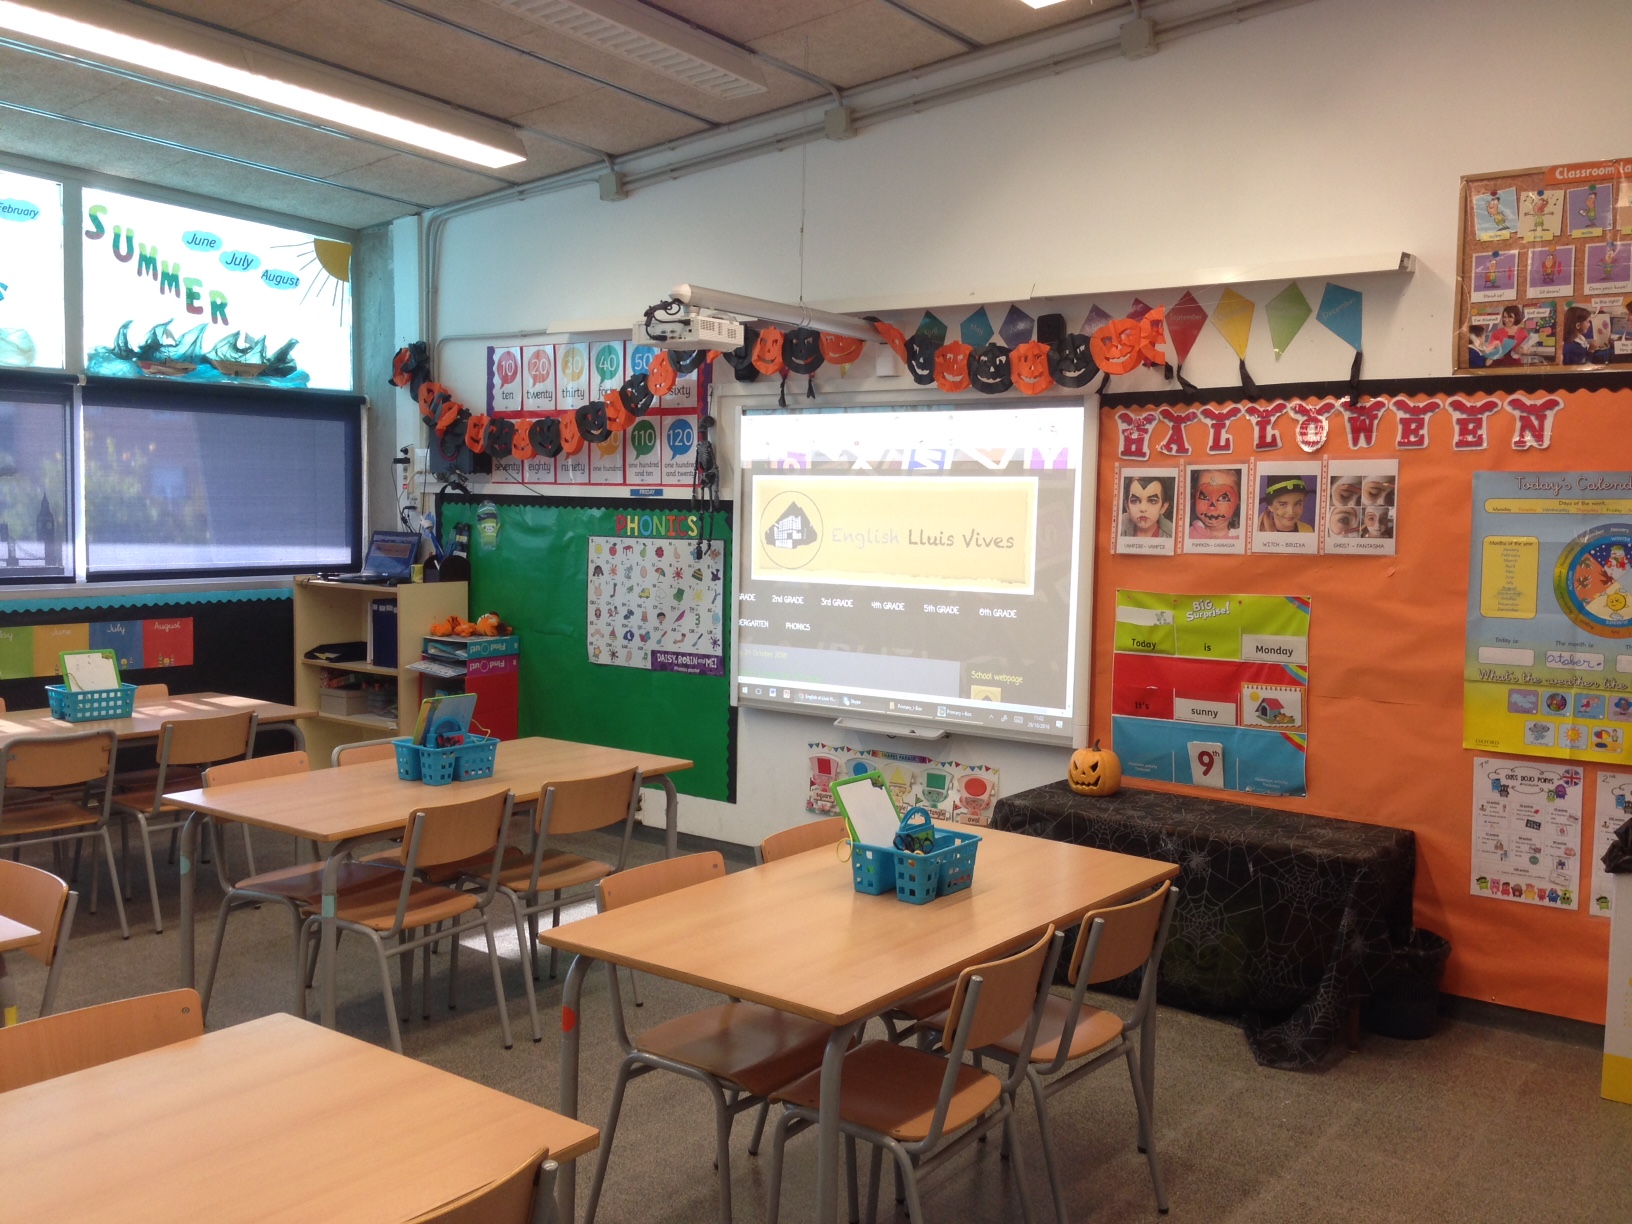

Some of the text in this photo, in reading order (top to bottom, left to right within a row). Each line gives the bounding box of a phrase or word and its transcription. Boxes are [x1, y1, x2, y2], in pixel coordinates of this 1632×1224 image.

[1555, 166, 1615, 180] Classroom
[186, 230, 217, 248] June
[84, 204, 230, 326] SUMMER
[225, 253, 254, 270] July
[261, 269, 300, 288] August
[1322, 298, 1356, 319] December
[1169, 313, 1203, 322] September
[969, 324, 984, 337] May
[501, 359, 515, 376] 10
[531, 358, 548, 374] 20
[565, 356, 582, 374] 30
[599, 354, 617, 371] 40
[502, 390, 514, 400] ten
[526, 389, 553, 402] twenty
[562, 387, 585, 401] thirty
[670, 384, 691, 399] sixty
[633, 429, 655, 446] 110
[667, 428, 694, 446] 120
[1120, 413, 1548, 458] HALLOWEEN
[494, 461, 521, 475] seventy
[528, 459, 551, 474] eighty
[561, 461, 585, 475] ninety
[603, 464, 623, 473] hundred
[638, 461, 659, 469] hundred
[635, 469, 644, 477] and
[666, 469, 676, 477] and
[1515, 476, 1573, 497] Today's
[616, 515, 698, 537] PHONICS
[833, 528, 1015, 550] English Lluis Vives
[1285, 541, 1306, 549] BRUIXA
[771, 595, 804, 604] 2nd GRADE
[820, 597, 853, 608] 3rd GRADE
[871, 601, 905, 611] 4th GRADE
[923, 604, 959, 614] 5th GRADE
[979, 607, 1017, 618] 6th GRADE
[1186, 601, 1231, 622] Surprise!
[52, 627, 72, 636] June
[107, 623, 126, 635] July
[154, 621, 181, 632] August
[785, 622, 810, 631] PHONICS
[490, 643, 506, 651] Find
[1132, 638, 1294, 657] Today is Monday
[489, 660, 505, 669] Find
[678, 655, 698, 665] ROBIN
[706, 657, 718, 668] ME!
[674, 665, 688, 673] Phonics
[971, 670, 1023, 686] School webpage
[1478, 669, 1629, 690] What's the weather like
[1135, 701, 1219, 717] It's sunny
[881, 751, 917, 762] SHAPES PARADE
[1198, 749, 1220, 777] 9th
[1521, 775, 1535, 783] DOJO
[816, 792, 832, 802] square
[967, 816, 980, 824] oval
